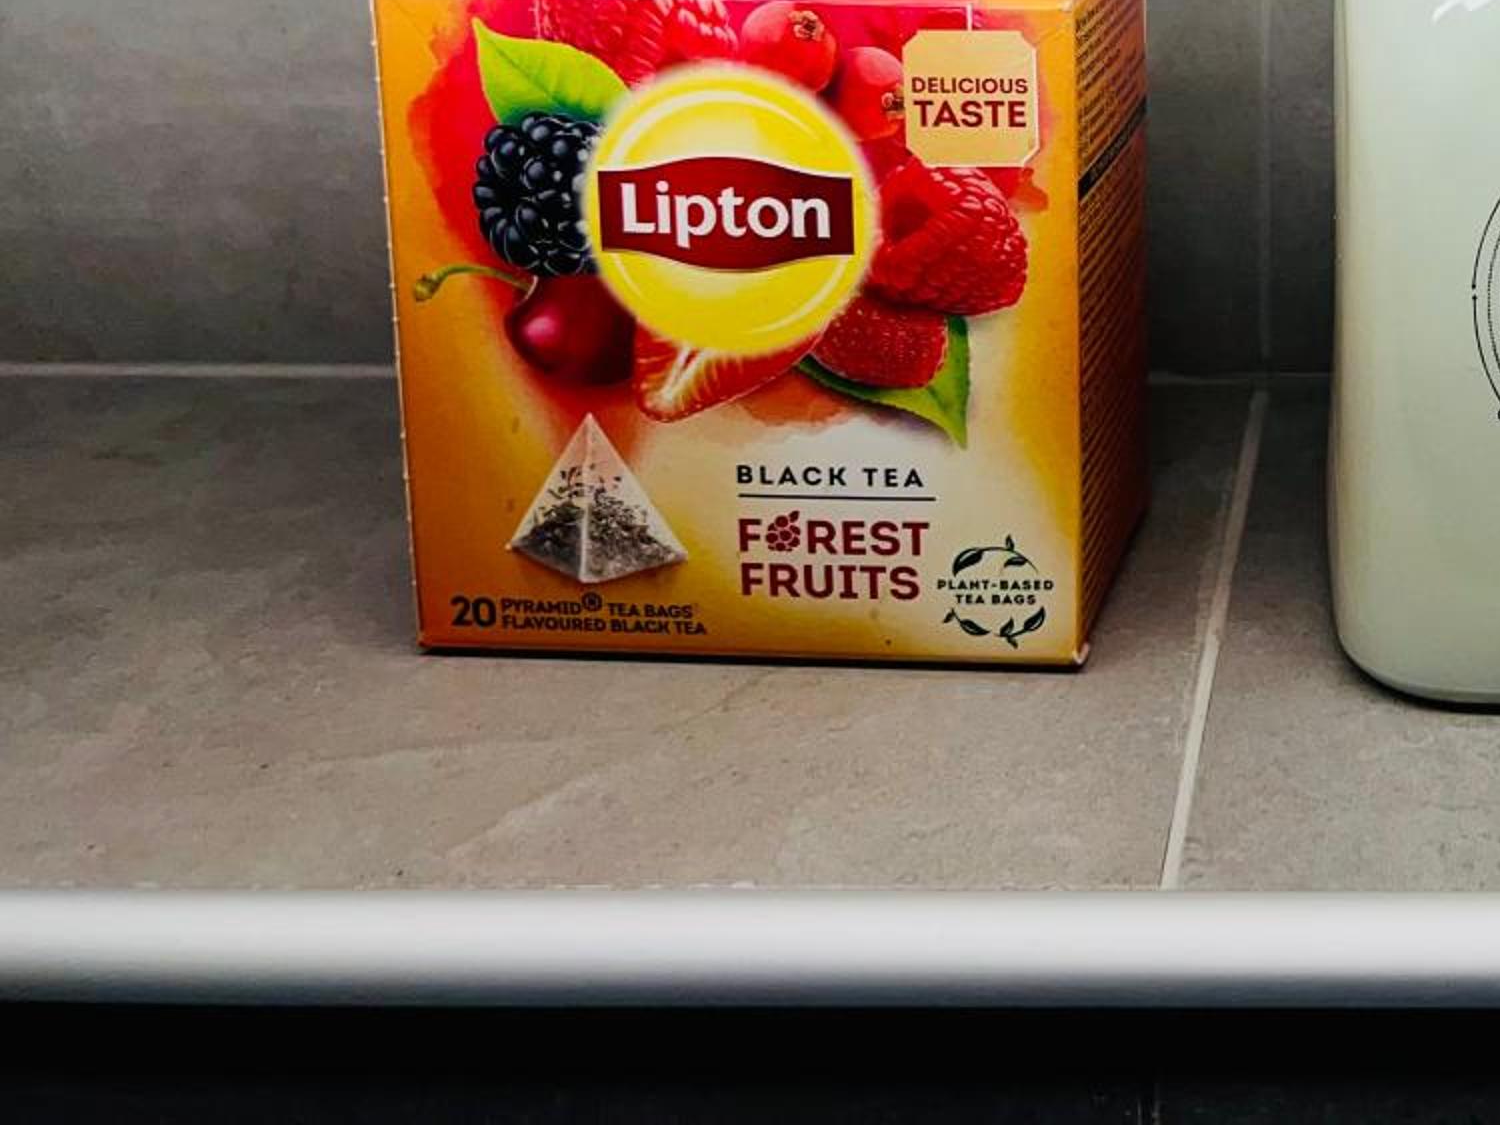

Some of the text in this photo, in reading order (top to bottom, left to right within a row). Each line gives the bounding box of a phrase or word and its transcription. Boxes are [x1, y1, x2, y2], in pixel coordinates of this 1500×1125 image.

[911, 77, 1029, 94] DELICIOUS
[912, 100, 1027, 128] TASTE
[619, 182, 831, 249] Lipton
[736, 464, 924, 487] BLACK TEA
[741, 562, 920, 601] FRUITS
[937, 579, 1054, 591] PLANT-BASED
[955, 594, 1037, 605] TEA BAGS
[451, 595, 497, 628] 20
[607, 602, 640, 618] TEA
[644, 603, 693, 620] BAGS
[501, 615, 708, 635] FLAVOURED BLACK TEA
